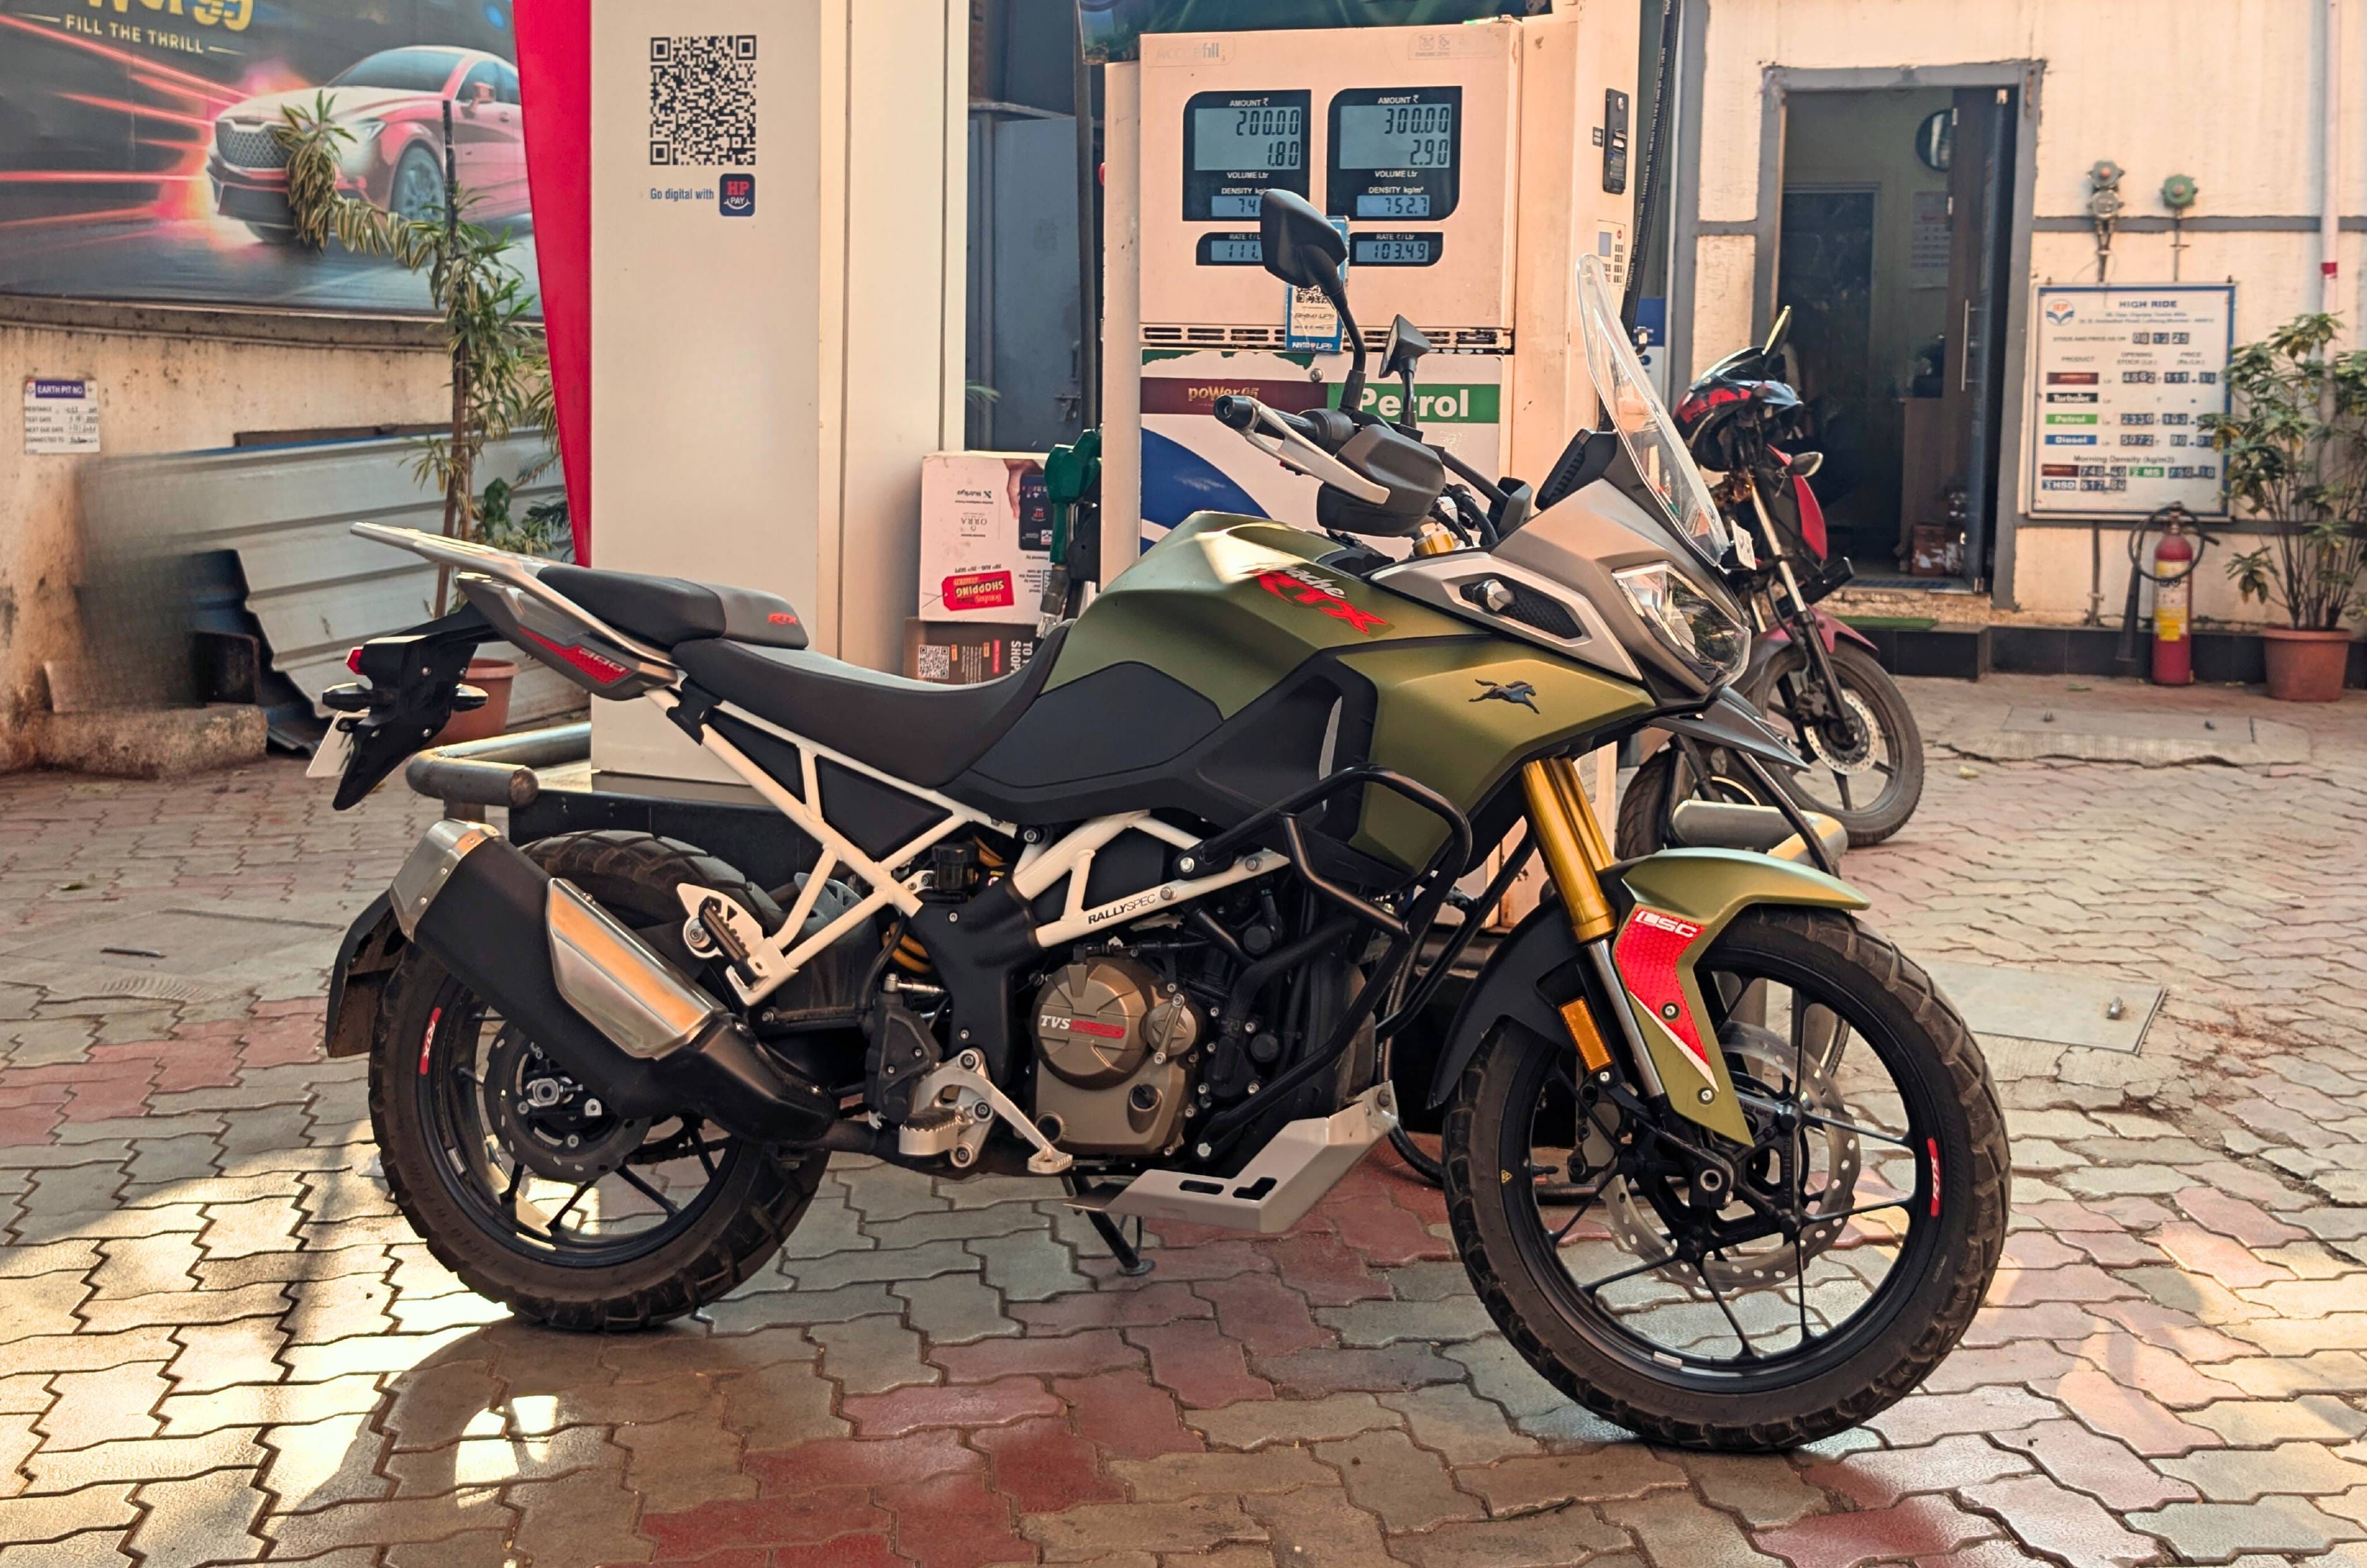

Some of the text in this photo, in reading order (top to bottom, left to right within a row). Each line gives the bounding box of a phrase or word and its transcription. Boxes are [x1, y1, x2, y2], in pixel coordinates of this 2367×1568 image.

[66, 14, 102, 35] FILL
[109, 22, 141, 43] THE
[149, 30, 204, 54] THRILL
[1229, 99, 1261, 107] AMOUNT
[1236, 109, 1300, 136] 200.00
[1384, 107, 1450, 134] 300.00
[1267, 141, 1299, 167] 1.80
[1409, 139, 1449, 165] 2.90
[650, 188, 714, 201] Go digital with
[727, 181, 750, 196] HP
[1385, 197, 1427, 213] 752.7
[1374, 243, 1427, 260] 103.49
[37, 385, 61, 394] EARTH
[61, 385, 71, 394] PIT
[1358, 388, 1469, 419] Perol
[2053, 481, 2076, 490] HSD
[961, 517, 988, 526] ORRA
[956, 579, 1005, 597] SHOPPING
[768, 612, 798, 626] RTX
[1023, 641, 1033, 656] TO
[1041, 1014, 1071, 1030] TVS
